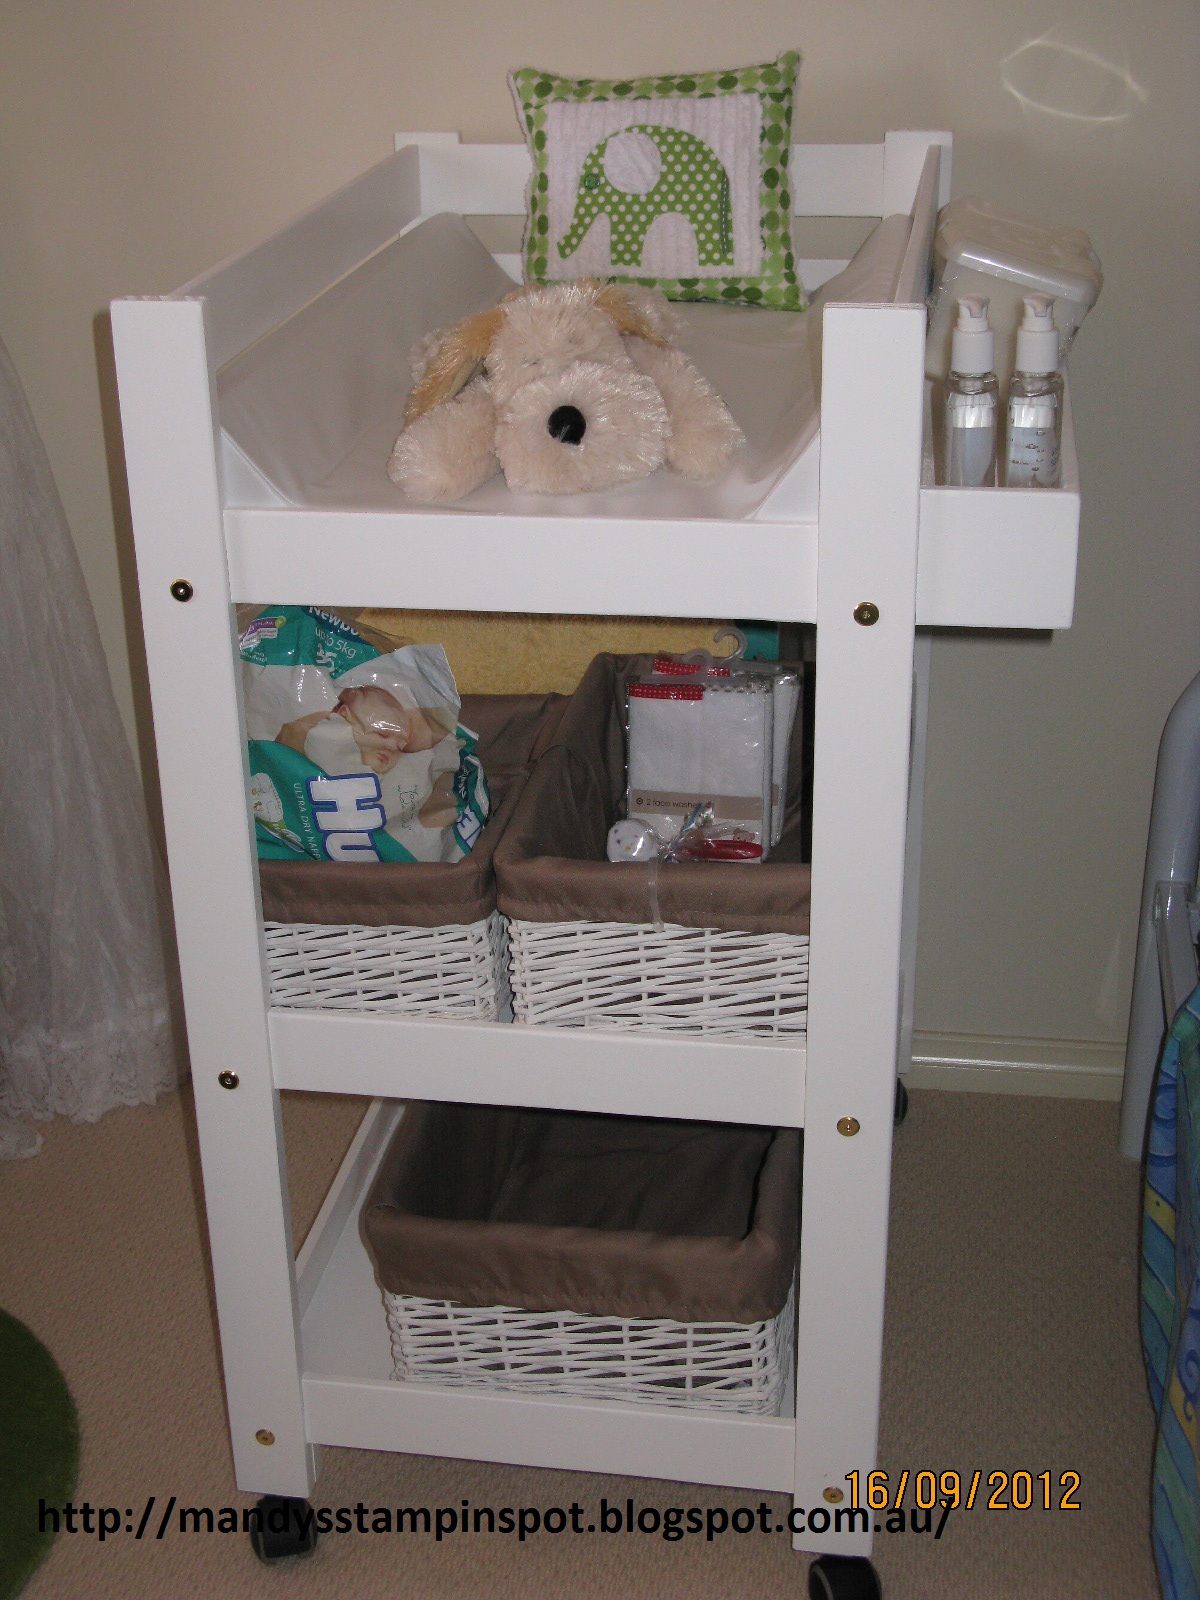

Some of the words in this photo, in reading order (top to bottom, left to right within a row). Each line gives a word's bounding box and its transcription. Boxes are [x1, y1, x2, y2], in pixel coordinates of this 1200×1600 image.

[335, 640, 357, 659] 5kg
[293, 782, 306, 812] ULTRA
[301, 815, 312, 833] DRY
[673, 800, 698, 808] washe
